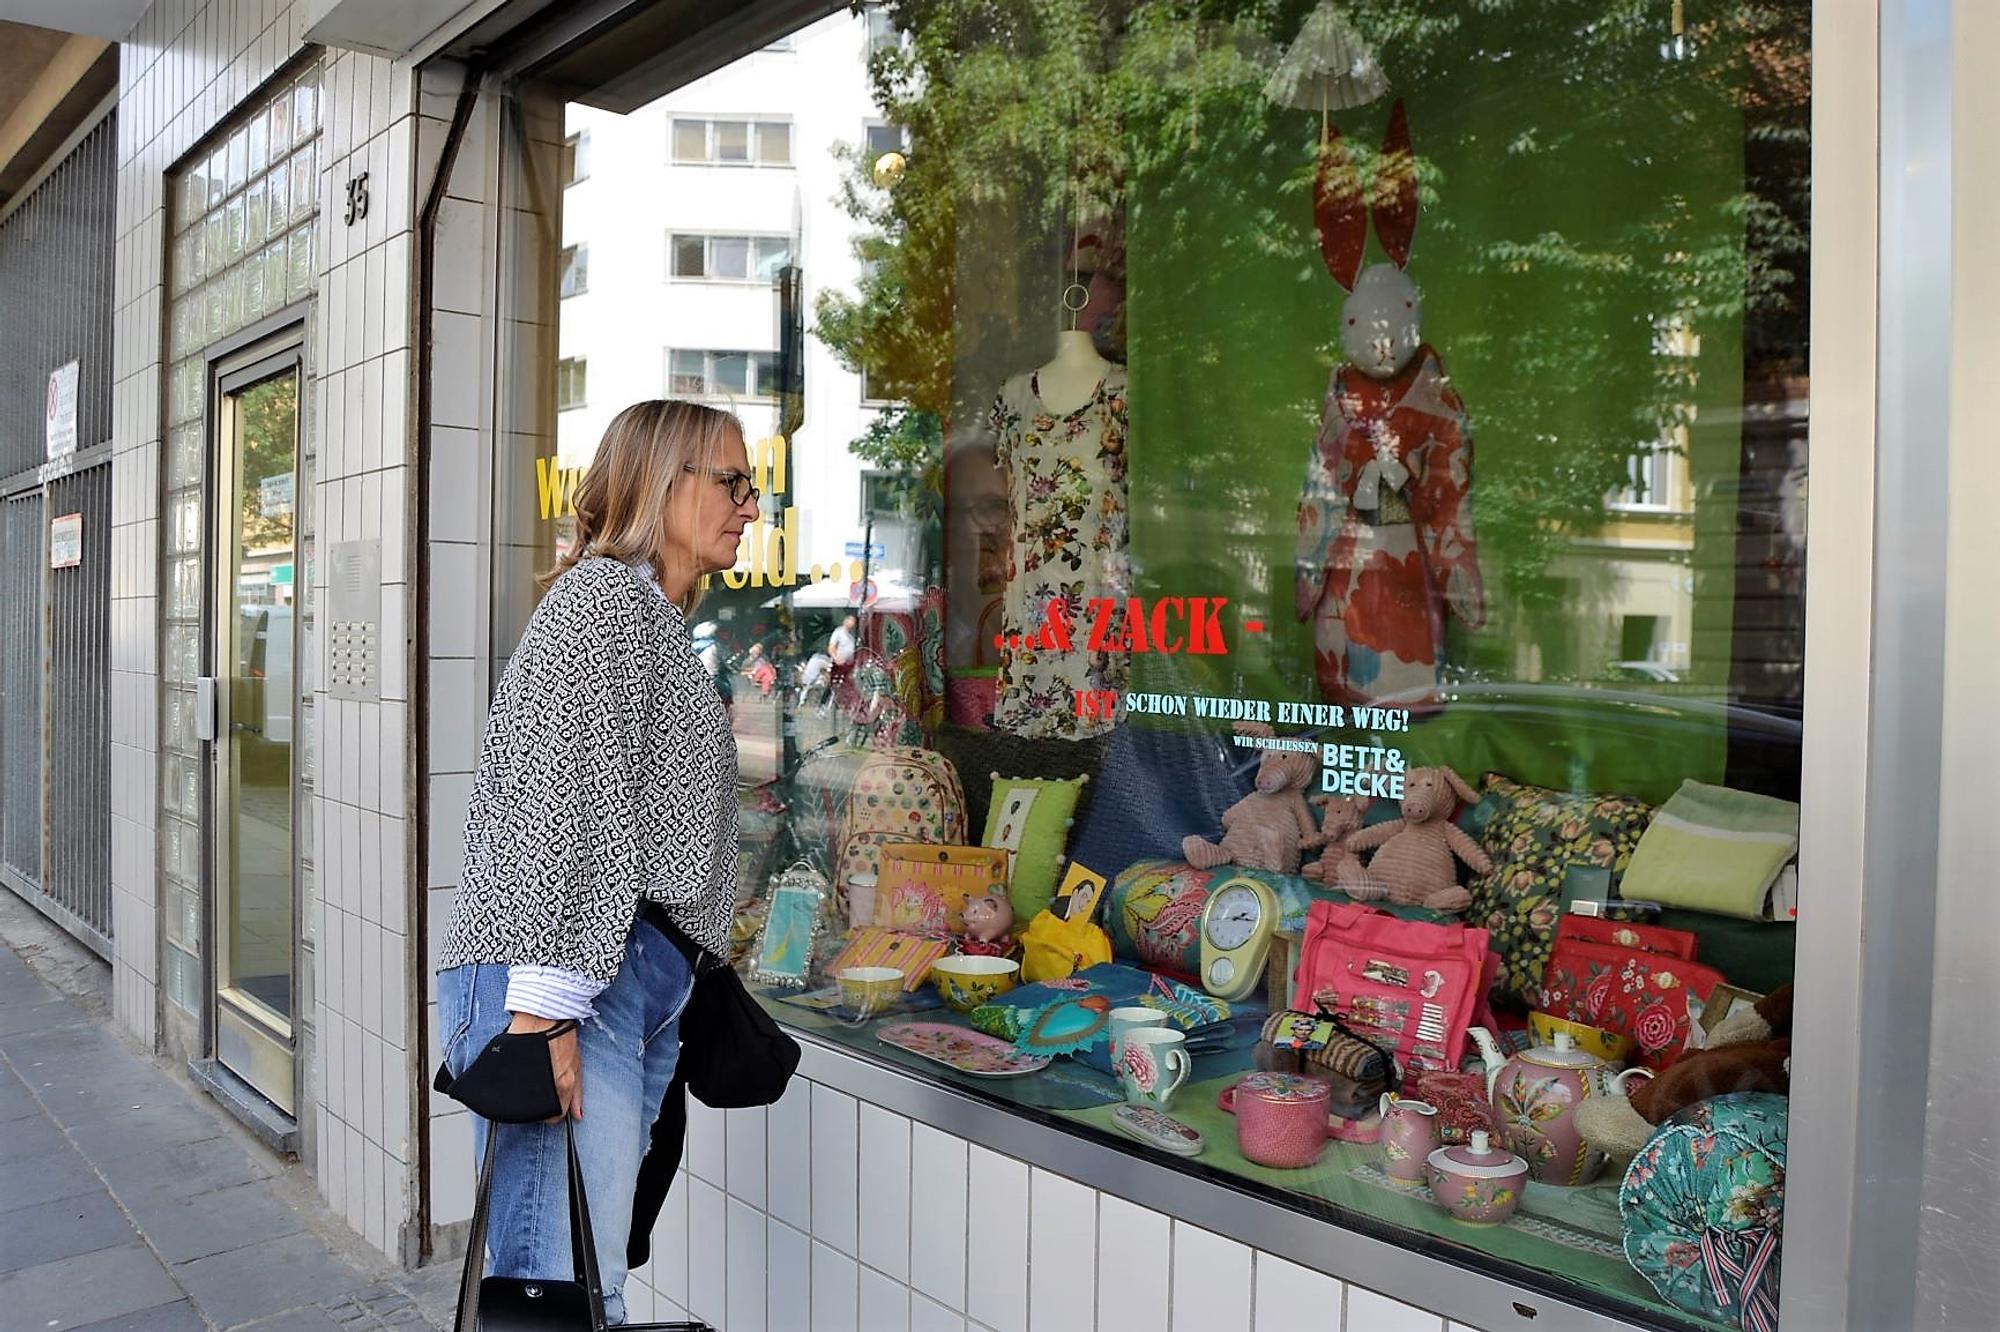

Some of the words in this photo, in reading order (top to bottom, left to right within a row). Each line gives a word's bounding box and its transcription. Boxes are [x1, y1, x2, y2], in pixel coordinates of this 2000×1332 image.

[344, 171, 369, 227] 35
[1087, 596, 1229, 655] ZACK
[1074, 688, 1118, 720] IST
[1125, 692, 1187, 716] SCHON
[1193, 696, 1272, 722] WIEDER
[1277, 701, 1346, 728] EINER
[1352, 706, 1410, 732] WEG!
[1233, 735, 1253, 748] WIR
[1255, 737, 1319, 754] SCHLIESSEN
[1323, 743, 1406, 774] BETT&
[1321, 769, 1406, 800] DECKE
